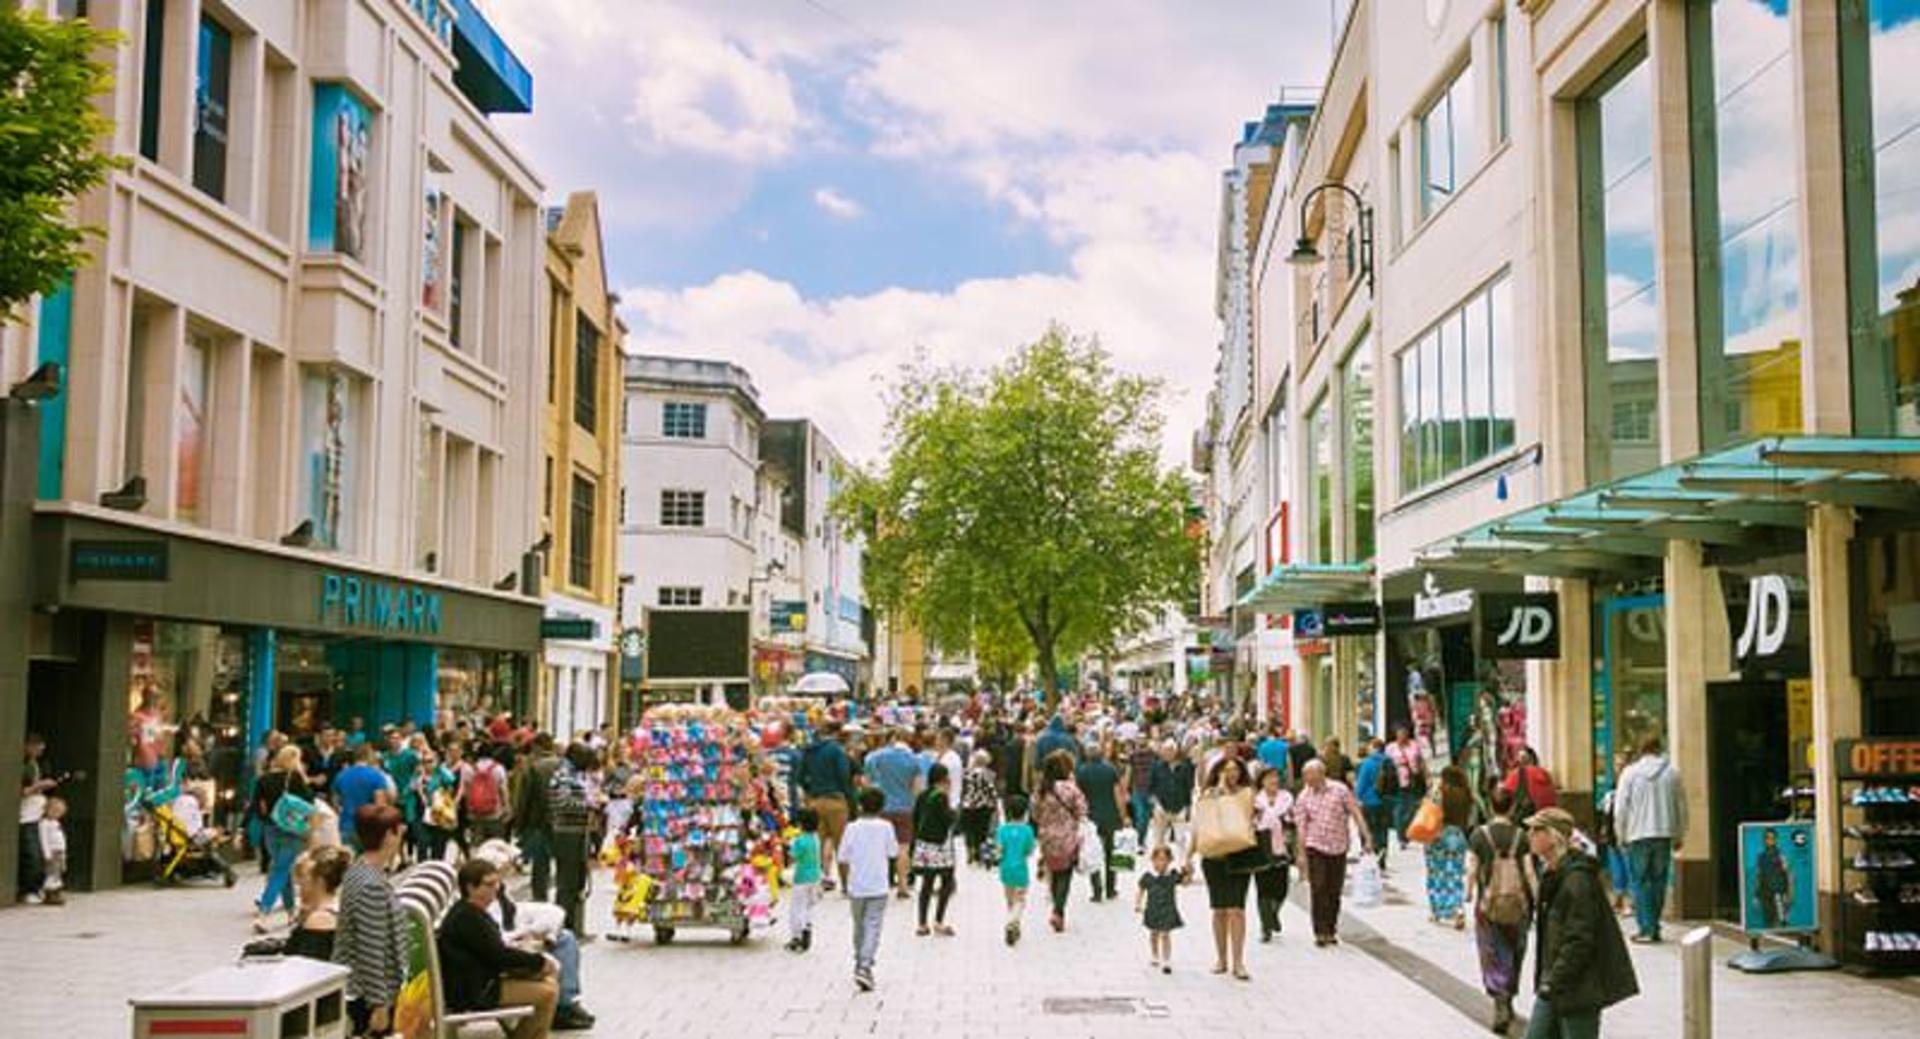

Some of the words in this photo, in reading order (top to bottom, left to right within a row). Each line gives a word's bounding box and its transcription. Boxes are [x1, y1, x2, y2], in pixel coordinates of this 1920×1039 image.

[322, 574, 443, 635] PRIMARK
[1497, 605, 1553, 646] JD
[1738, 573, 1789, 659] JD
